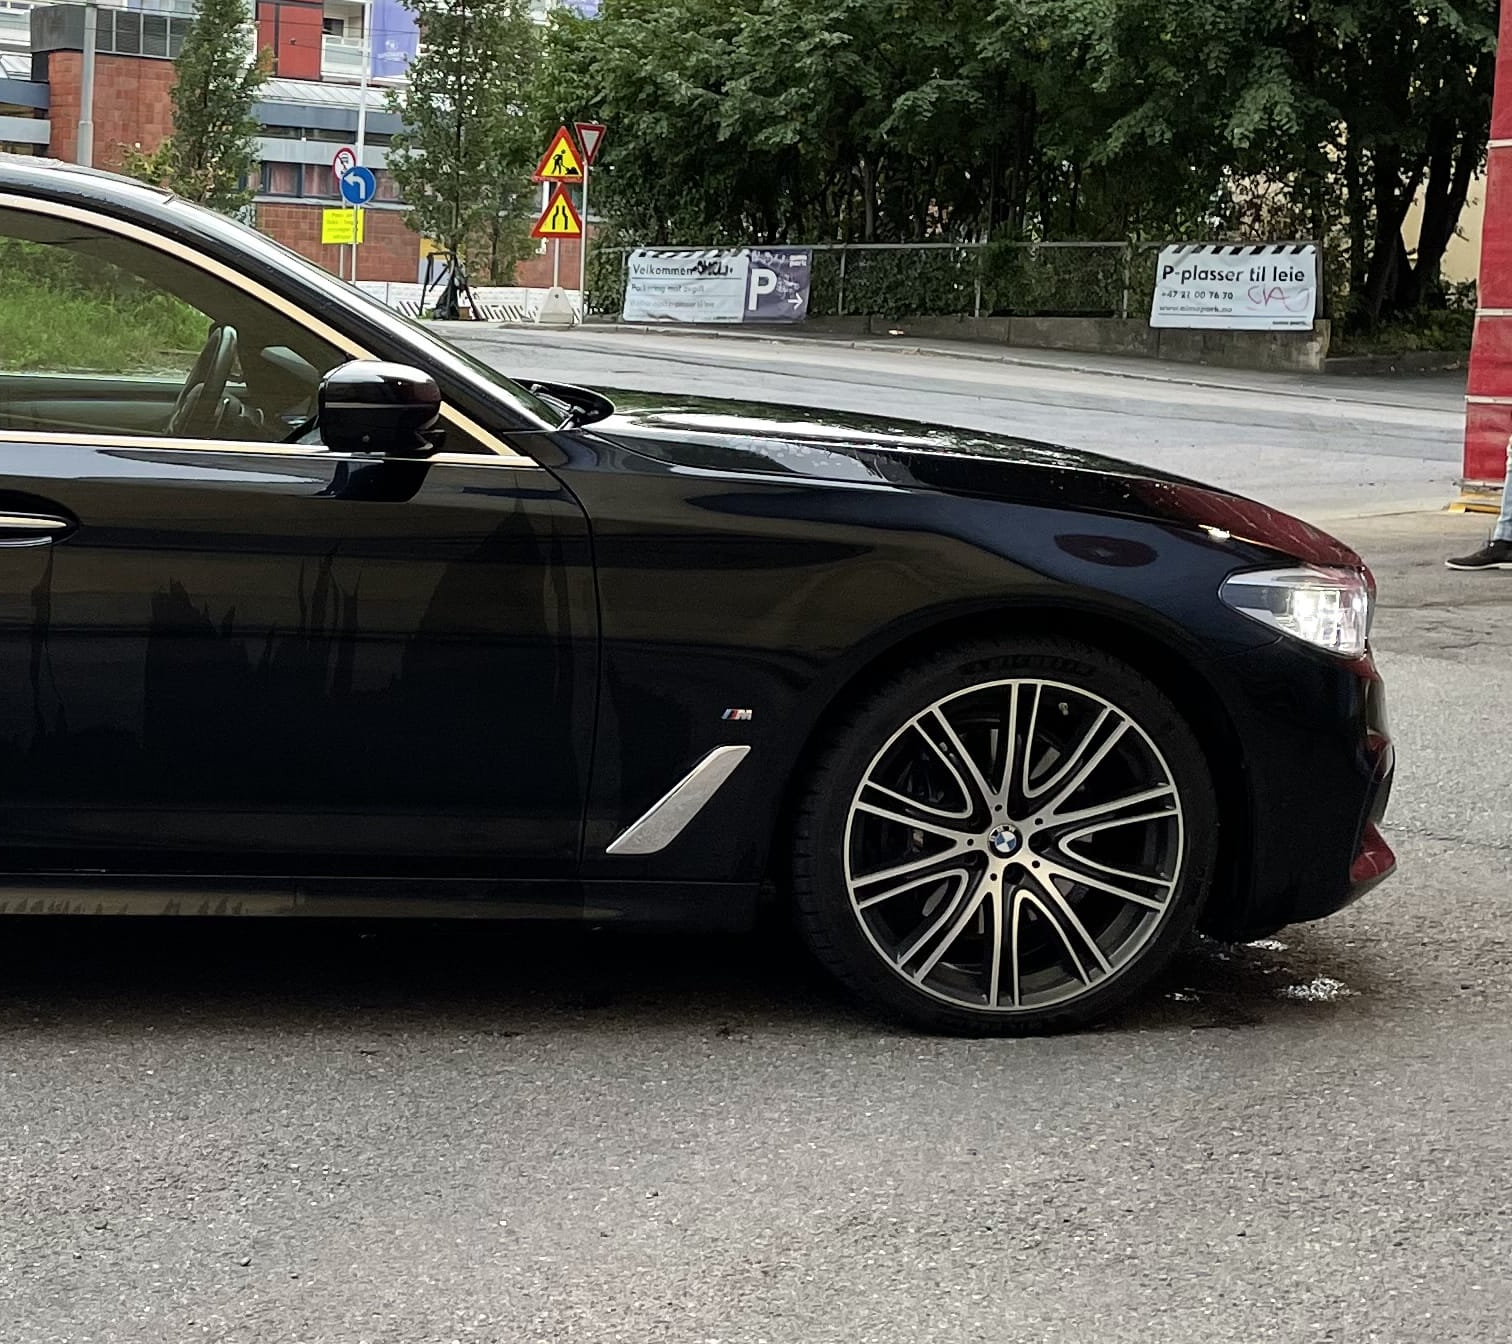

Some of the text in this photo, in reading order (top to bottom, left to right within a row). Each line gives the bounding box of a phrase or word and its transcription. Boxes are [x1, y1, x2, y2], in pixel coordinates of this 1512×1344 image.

[633, 263, 693, 276] Velkommen
[1162, 264, 1305, 285] P-plasser til leie
[748, 268, 778, 311] P
[1194, 291, 1206, 299] 00
[1222, 291, 1234, 300] 70
